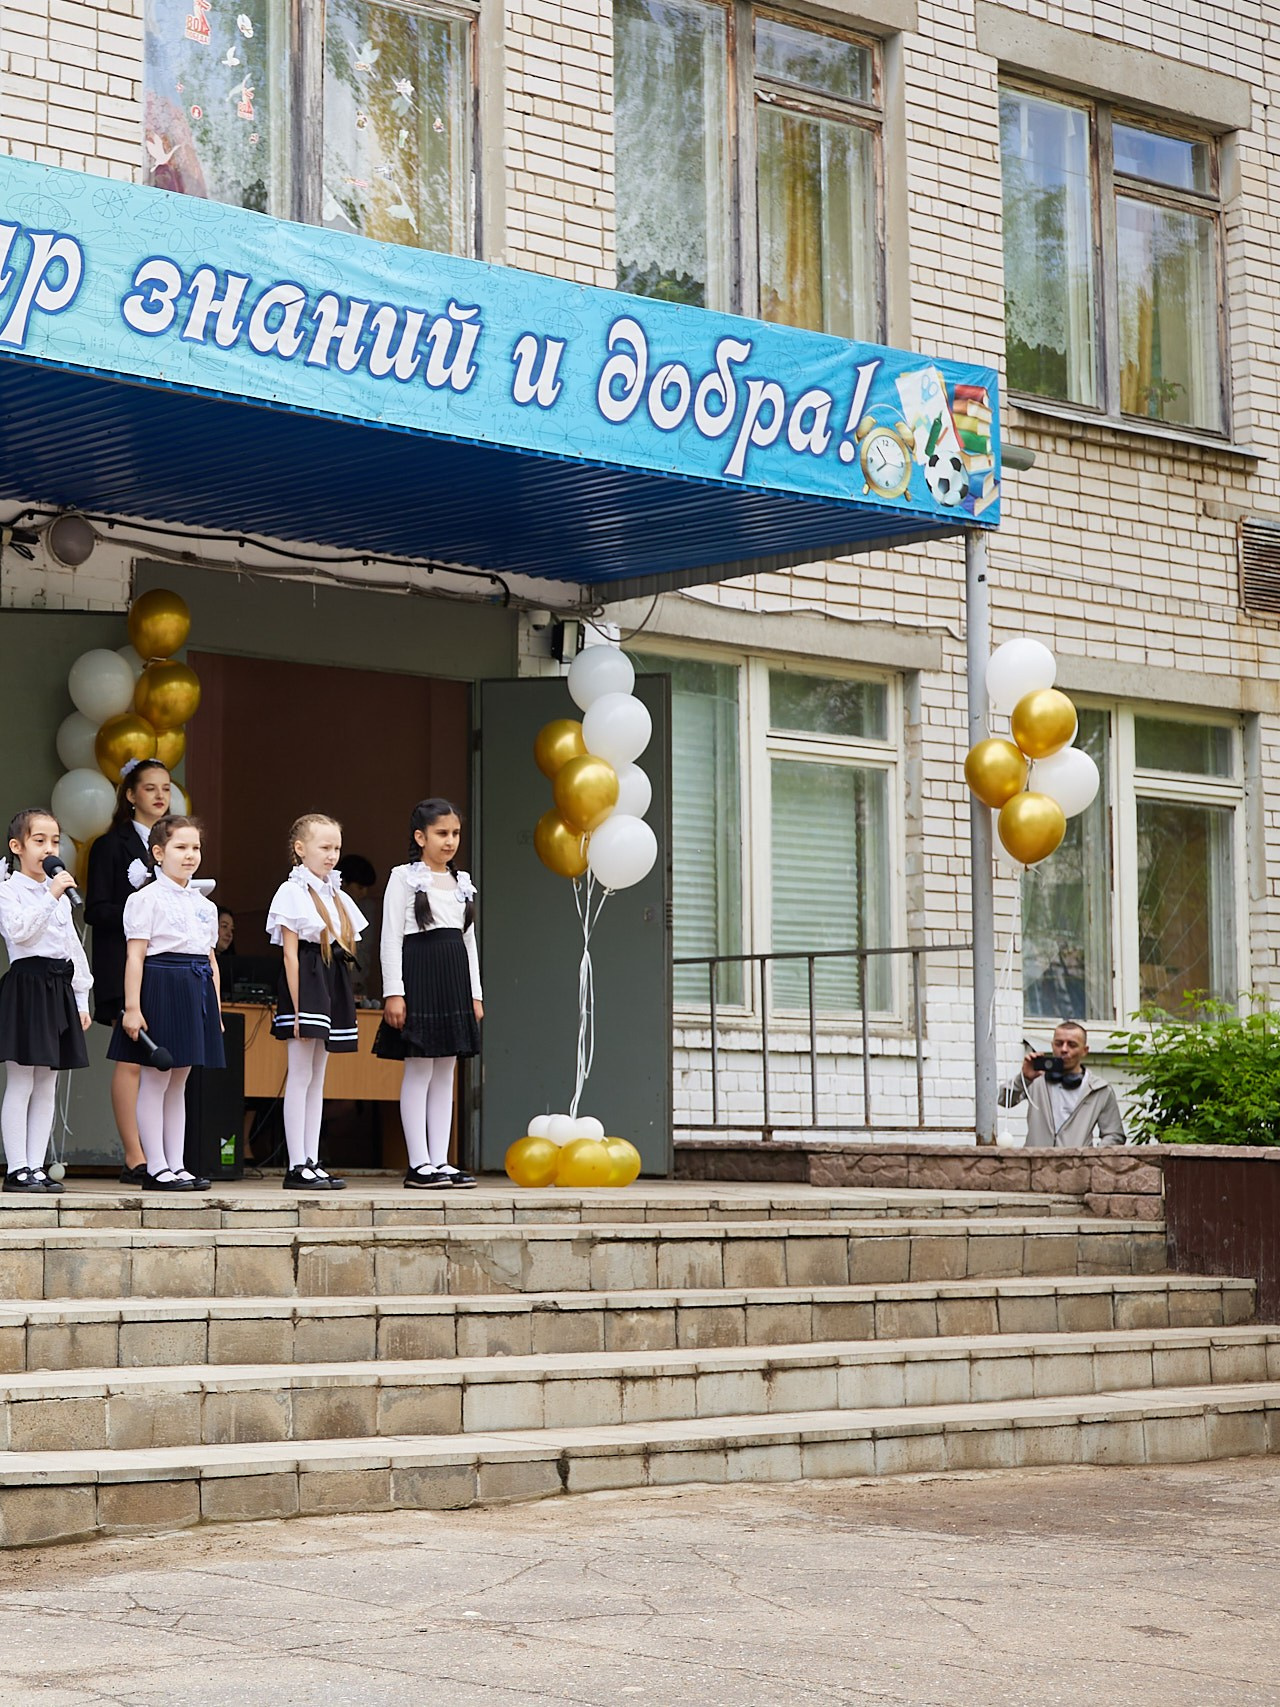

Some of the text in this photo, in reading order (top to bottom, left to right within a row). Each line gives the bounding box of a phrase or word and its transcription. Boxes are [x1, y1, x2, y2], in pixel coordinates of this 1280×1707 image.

[120, 255, 484, 393] знаний
[510, 329, 568, 410] и
[597, 314, 885, 478] добра!
